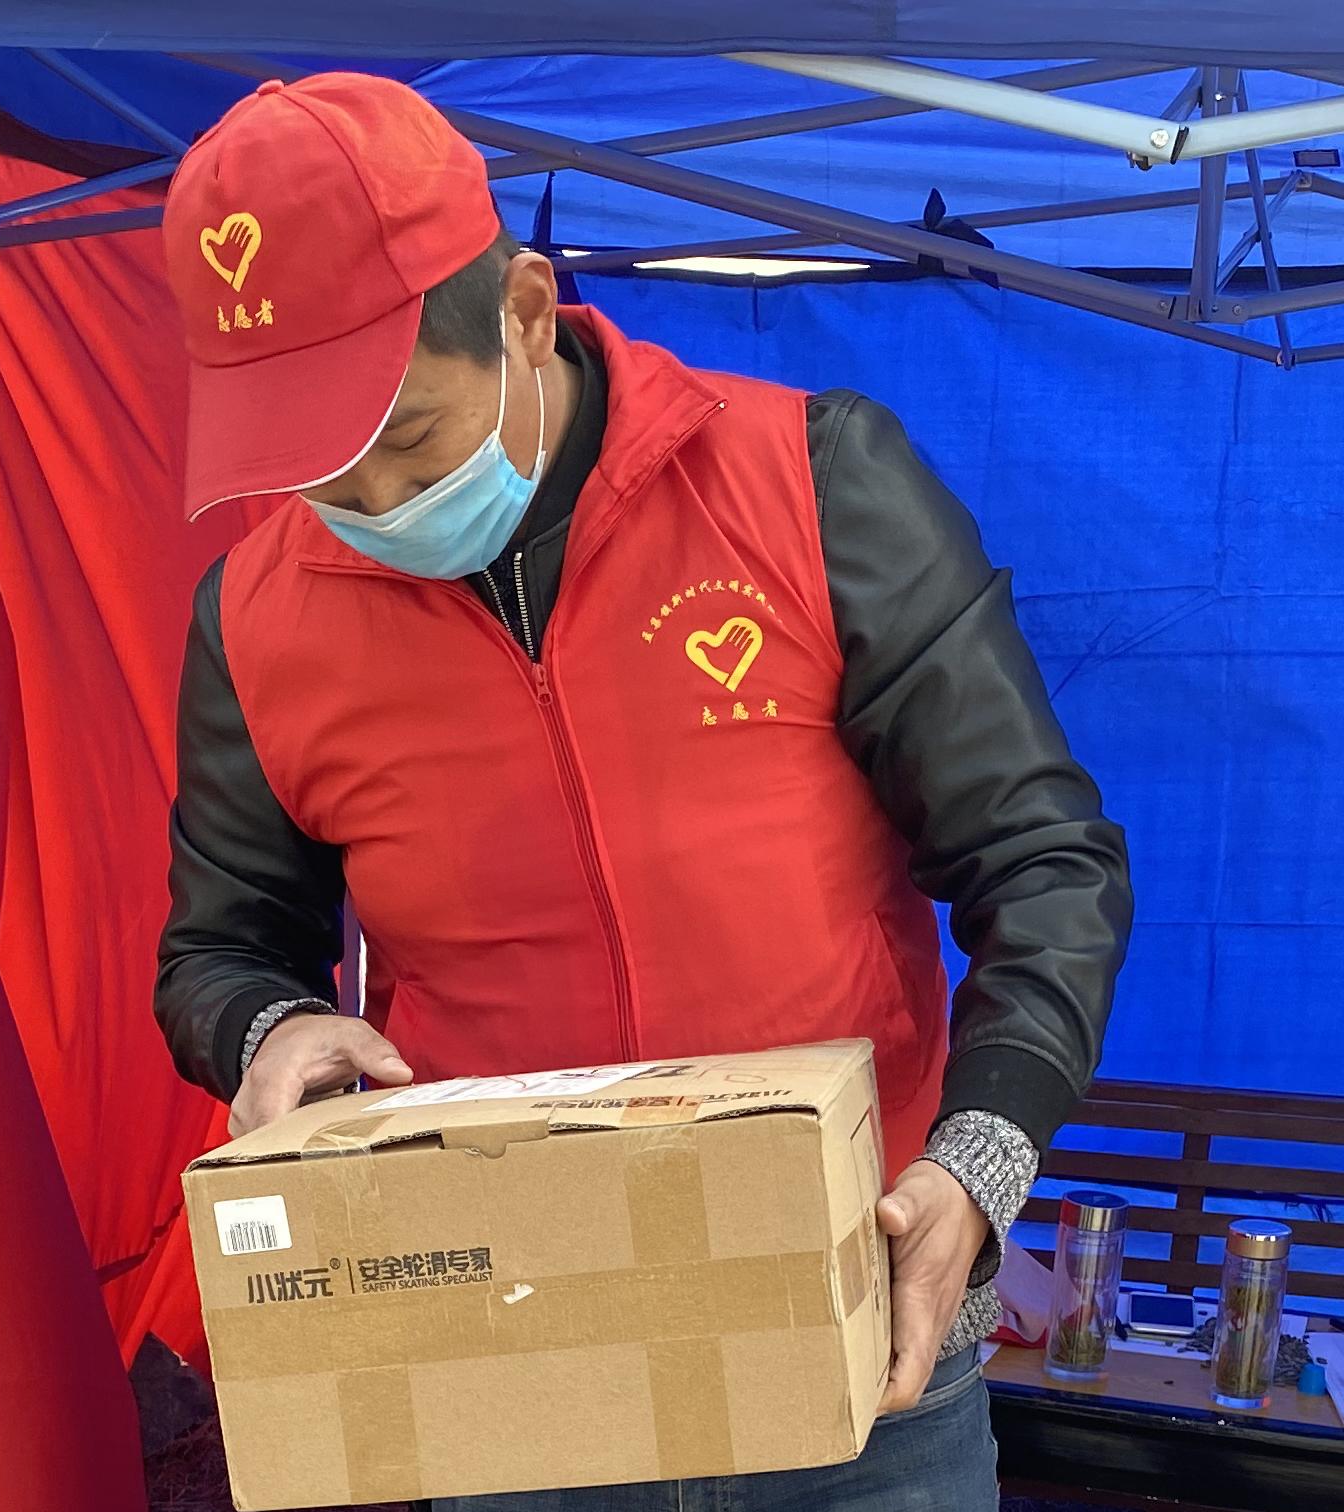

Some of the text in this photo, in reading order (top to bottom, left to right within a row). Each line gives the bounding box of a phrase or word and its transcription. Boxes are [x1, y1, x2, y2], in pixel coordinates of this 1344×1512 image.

[217, 297, 274, 333] 志愿者
[700, 698, 778, 728] 志愿者
[358, 1247, 493, 1282] 安全轮滑专家
[362, 1271, 494, 1294] SAFETY SKATING SPECIALIST
